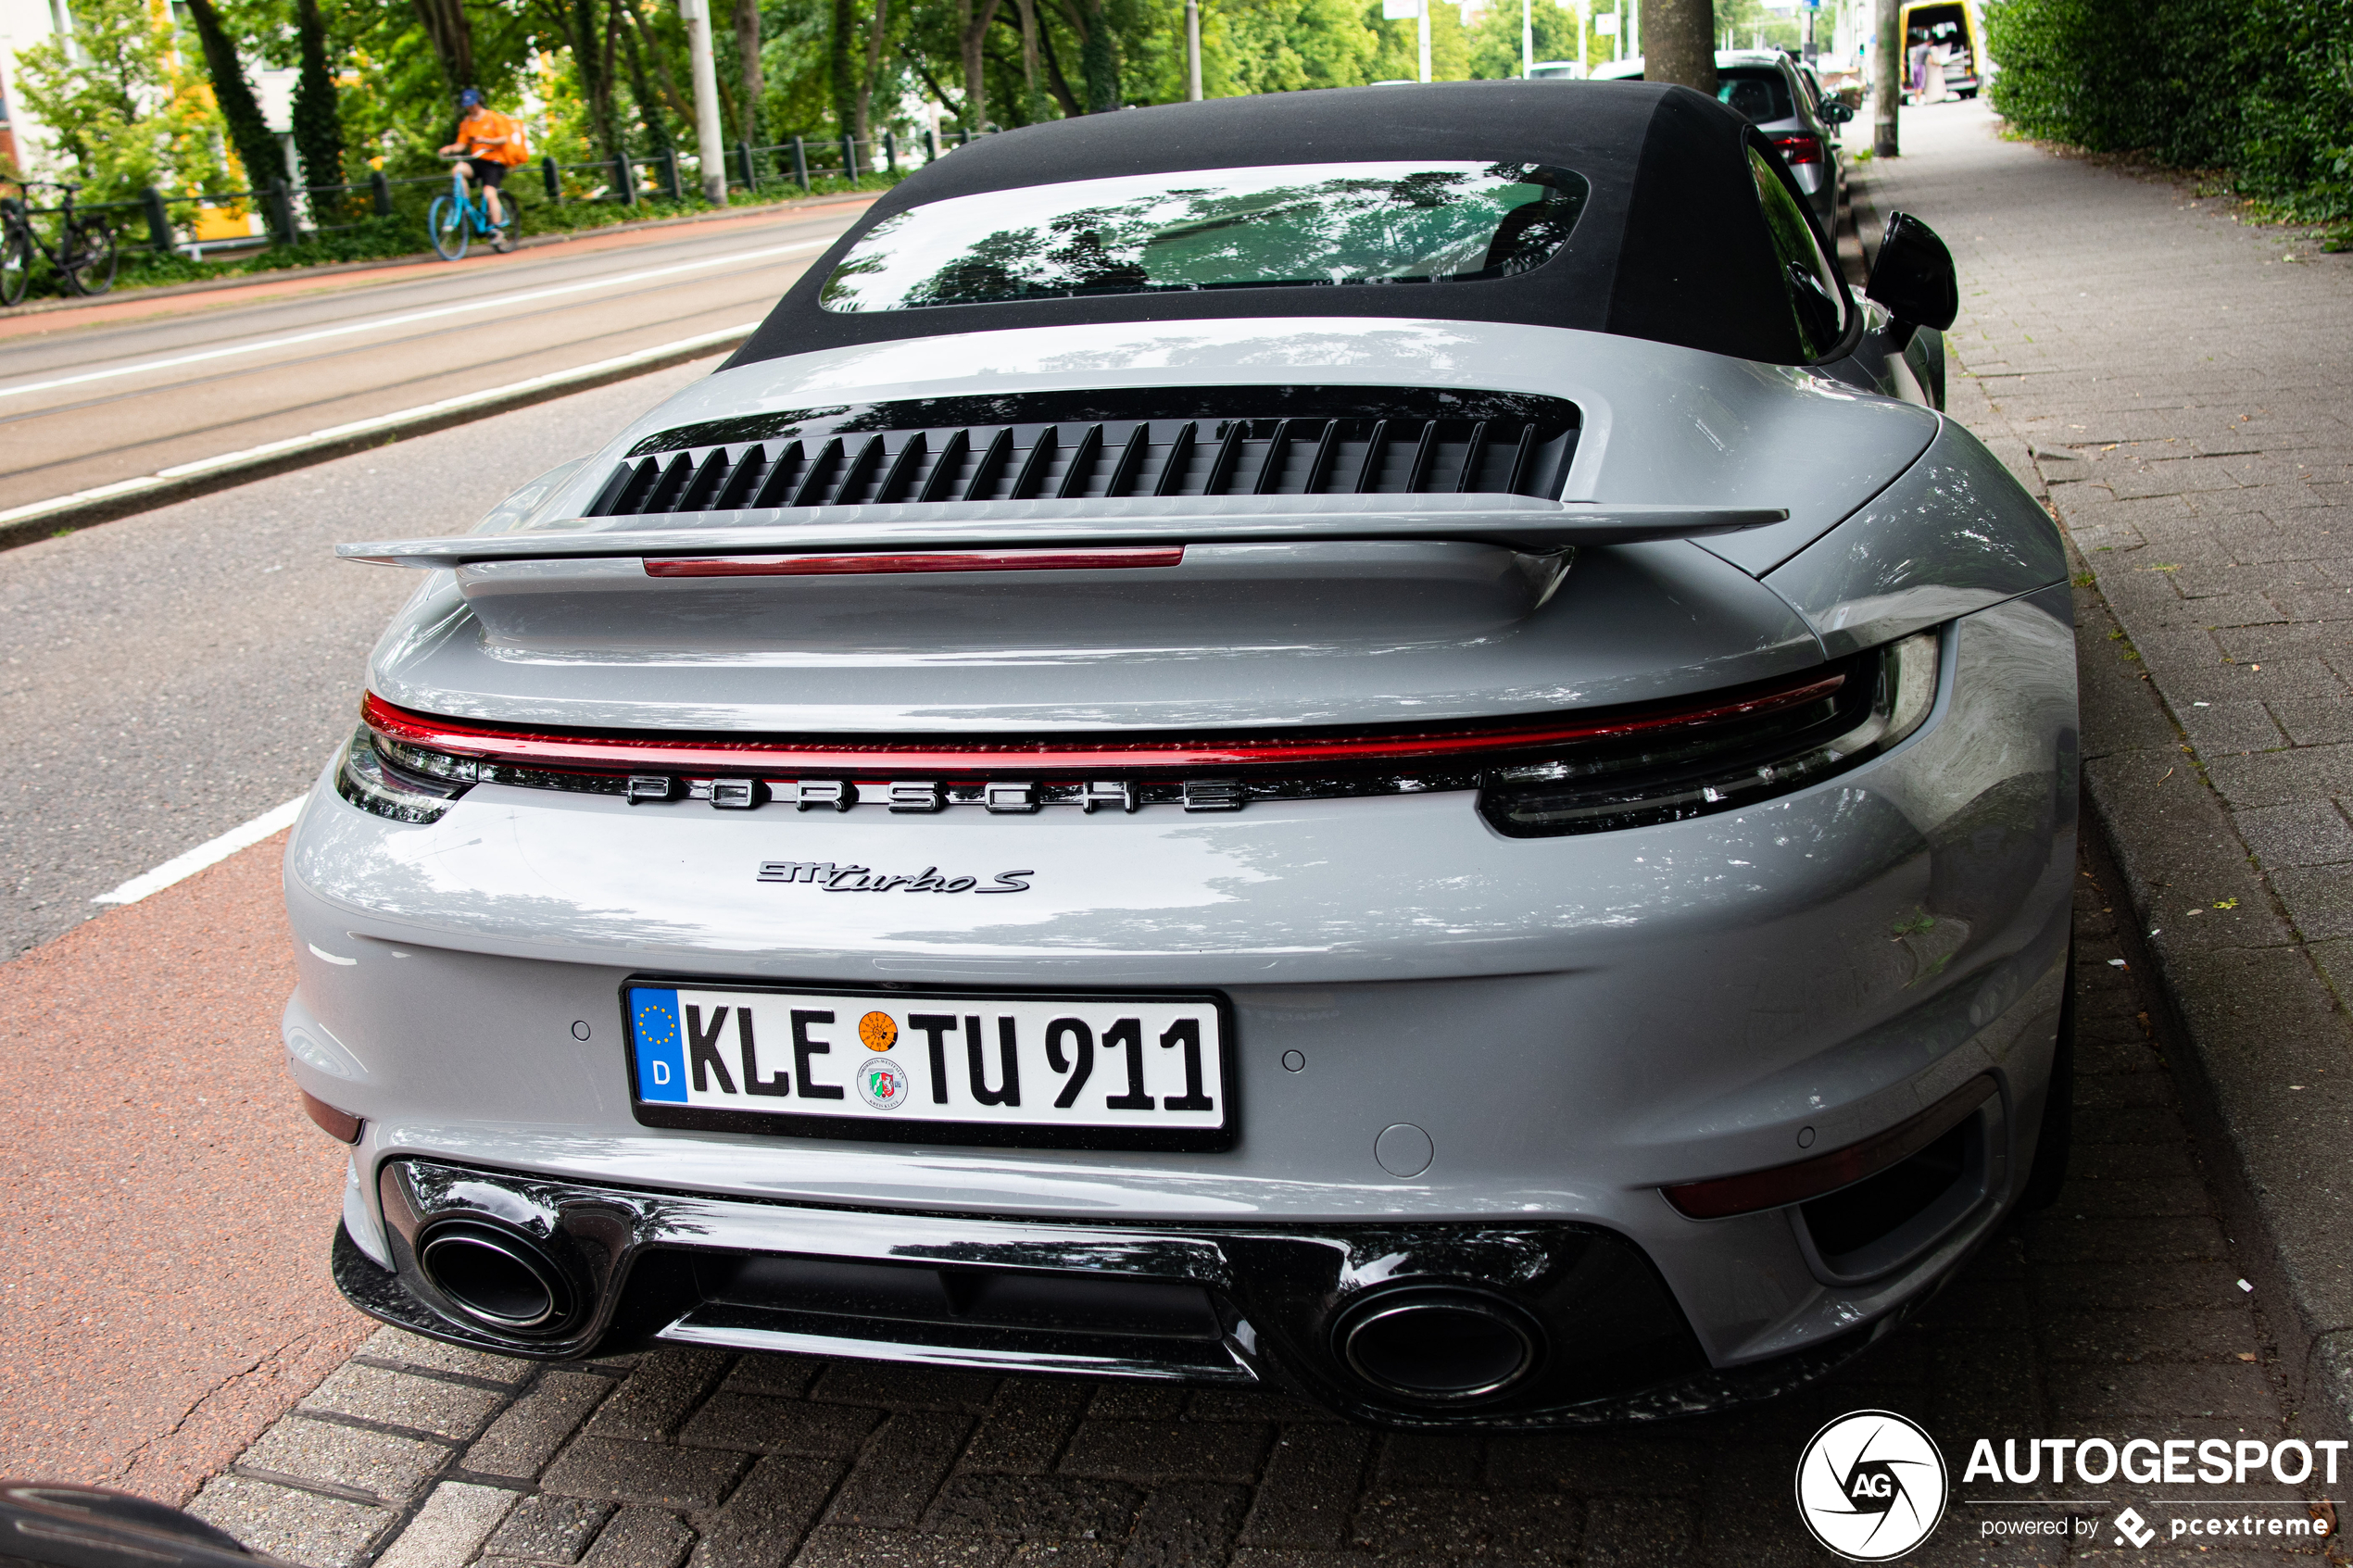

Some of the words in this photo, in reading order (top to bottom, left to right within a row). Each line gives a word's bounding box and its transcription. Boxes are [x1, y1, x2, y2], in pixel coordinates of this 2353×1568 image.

[627, 775, 1246, 813] PORSCHE
[653, 1060, 671, 1085] D
[686, 1003, 845, 1100] KLE
[908, 1011, 1022, 1108] TU
[1044, 1016, 1214, 1112] 911
